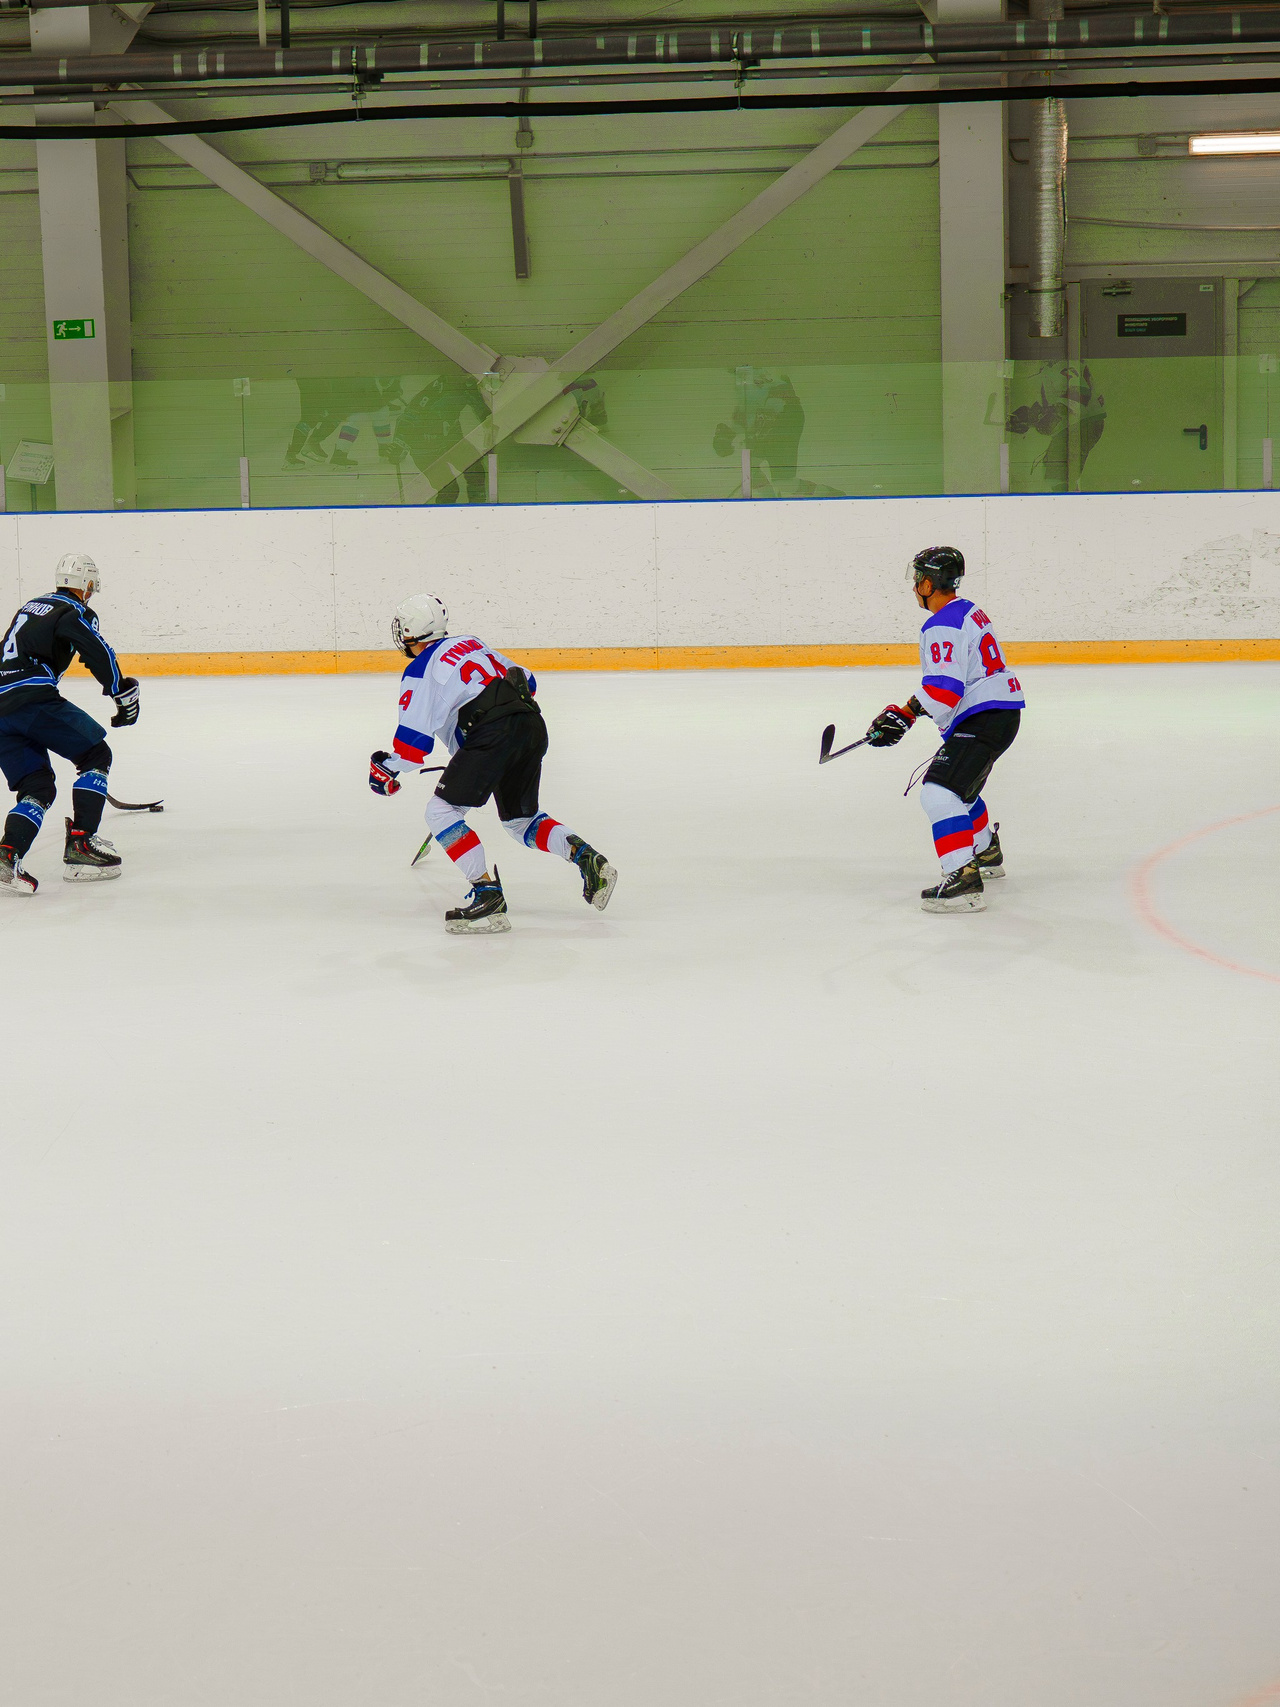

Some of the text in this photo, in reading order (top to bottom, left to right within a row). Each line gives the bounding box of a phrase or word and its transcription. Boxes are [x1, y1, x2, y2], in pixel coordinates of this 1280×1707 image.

[2, 613, 28, 662] 8
[930, 641, 953, 664] 87
[399, 689, 413, 711] 4
